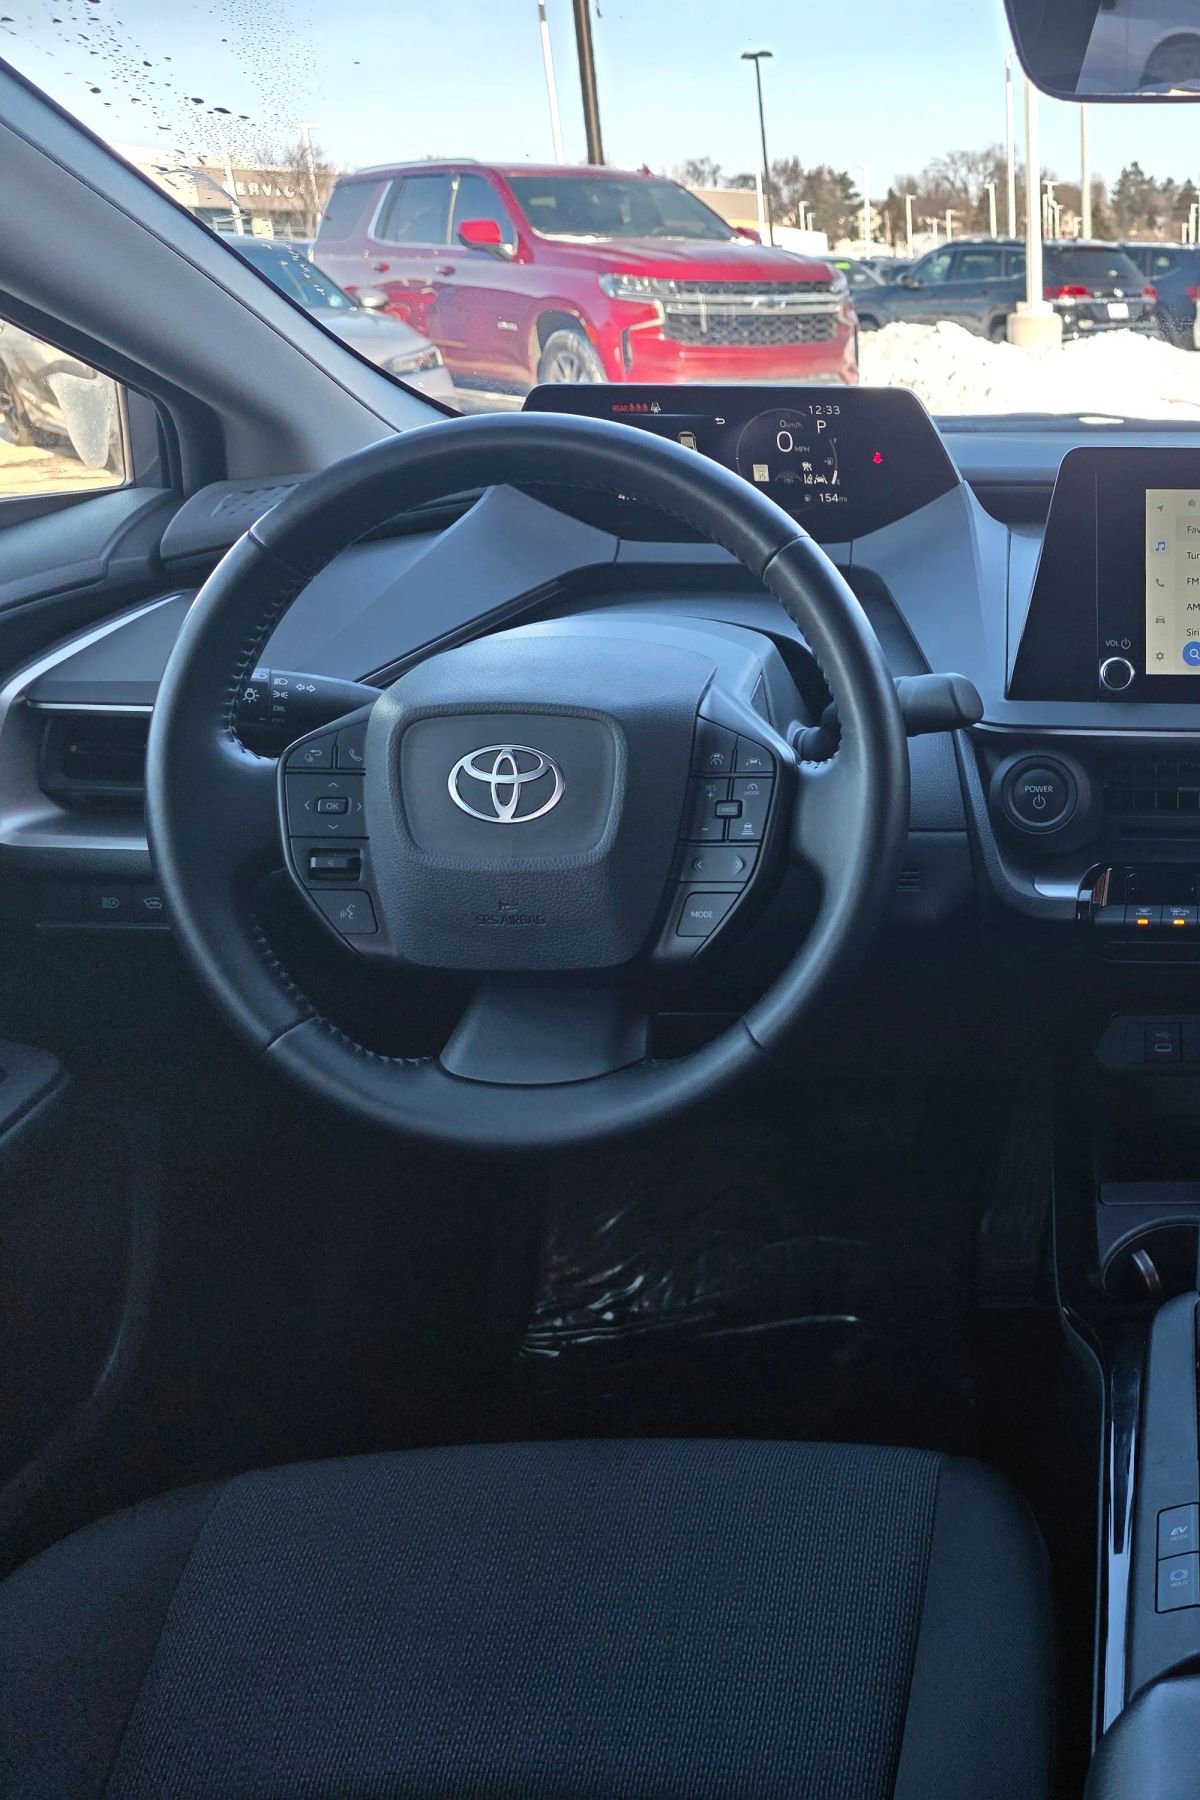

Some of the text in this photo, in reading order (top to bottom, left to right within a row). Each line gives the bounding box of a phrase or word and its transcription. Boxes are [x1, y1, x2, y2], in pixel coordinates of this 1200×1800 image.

[808, 405, 841, 415] 12:33
[816, 420, 827, 434] P
[776, 430, 793, 453] 0
[819, 493, 839, 502] 154
[1186, 577, 1200, 586] FM
[1186, 603, 1200, 611] AM
[1105, 639, 1119, 647] VOL
[1024, 785, 1054, 793] POWER
[325, 802, 340, 810] OK
[690, 910, 713, 918] MODE
[1170, 1525, 1188, 1536] EV
